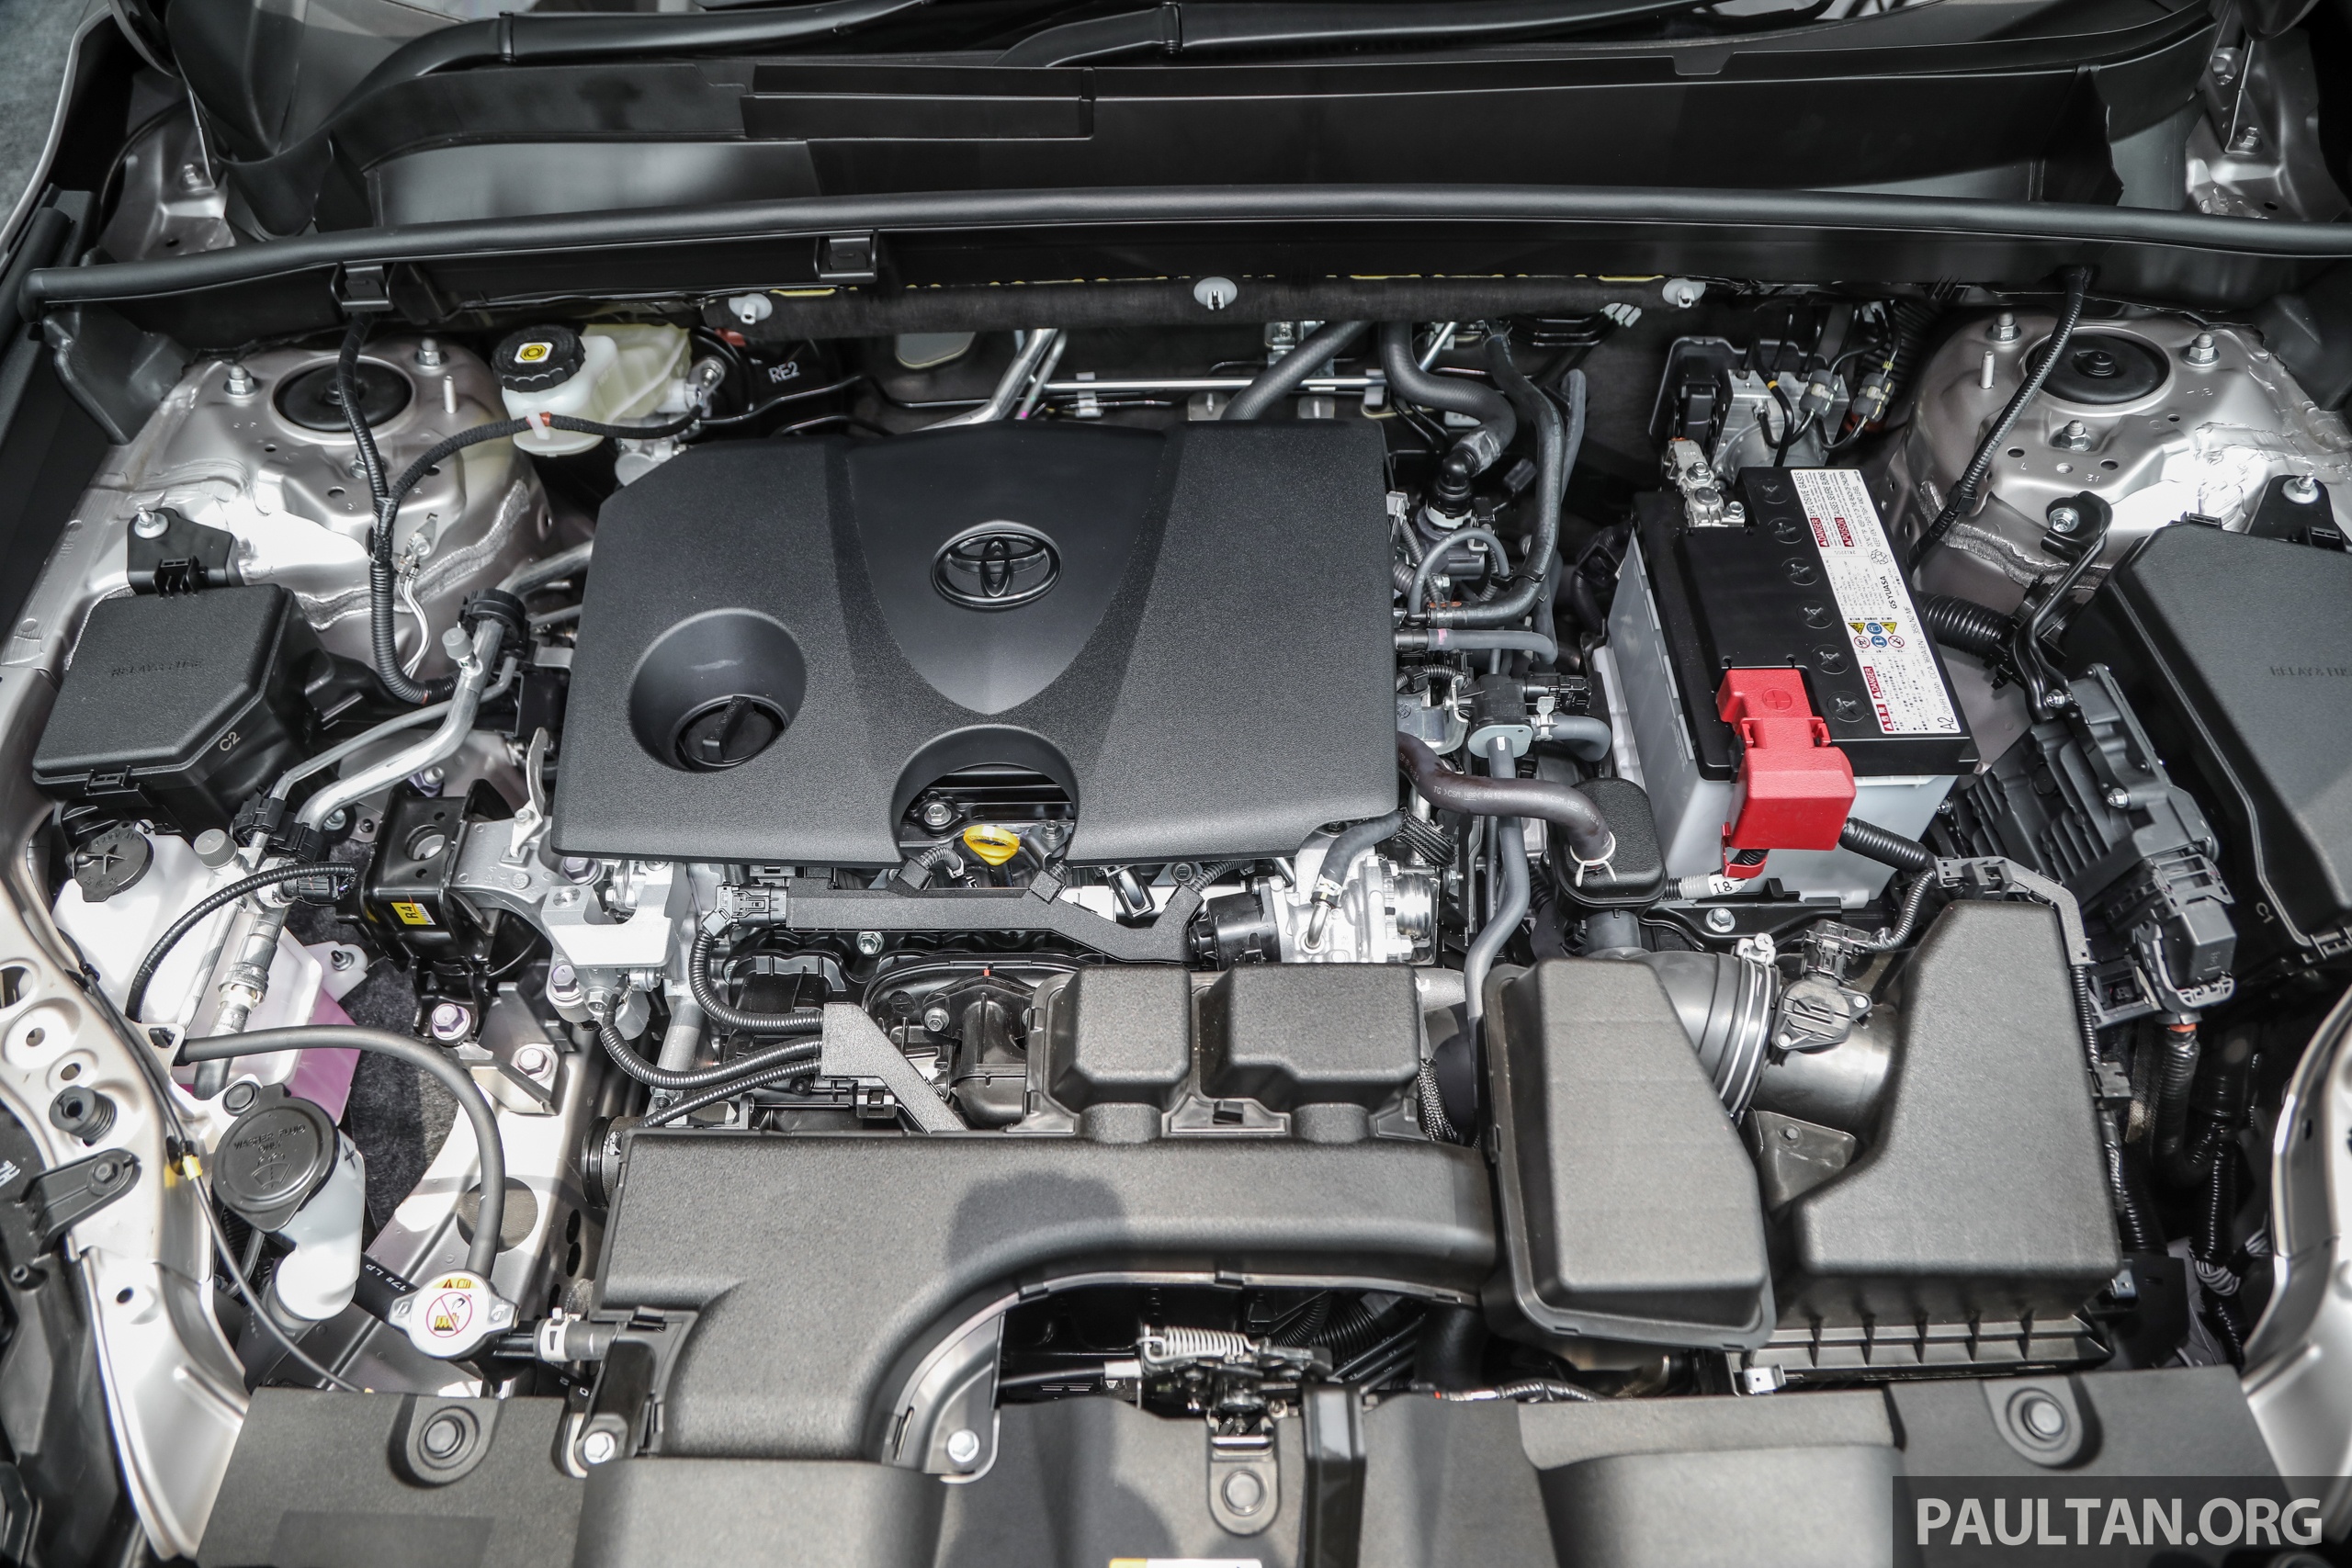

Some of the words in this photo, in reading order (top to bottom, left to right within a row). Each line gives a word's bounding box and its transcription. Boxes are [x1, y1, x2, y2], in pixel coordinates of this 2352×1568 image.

[768, 361, 800, 383] RE2
[1793, 471, 1807, 488] GASES
[1817, 471, 1830, 485] BURNS
[1823, 486, 1836, 500] SEVERE
[1851, 485, 1861, 496] LEVEL
[1800, 490, 1818, 516] EXPLOSIVE
[1856, 496, 1865, 504] AND
[1828, 501, 1841, 516] CAUSES
[1812, 518, 1826, 541] DANGER
[1837, 518, 1850, 540] POISON
[1880, 575, 1893, 599] YUASA
[1887, 600, 1898, 609] GS
[1864, 667, 1879, 691] DANGER
[1927, 665, 1938, 678] CCA
[1937, 716, 1957, 730] A2
[220, 731, 241, 751] C2
[1713, 880, 1733, 895] 18
[400, 906, 419, 919] R4
[2256, 902, 2274, 923] C1
[233, 1133, 274, 1150] WASHER
[278, 1123, 306, 1137] FLUID
